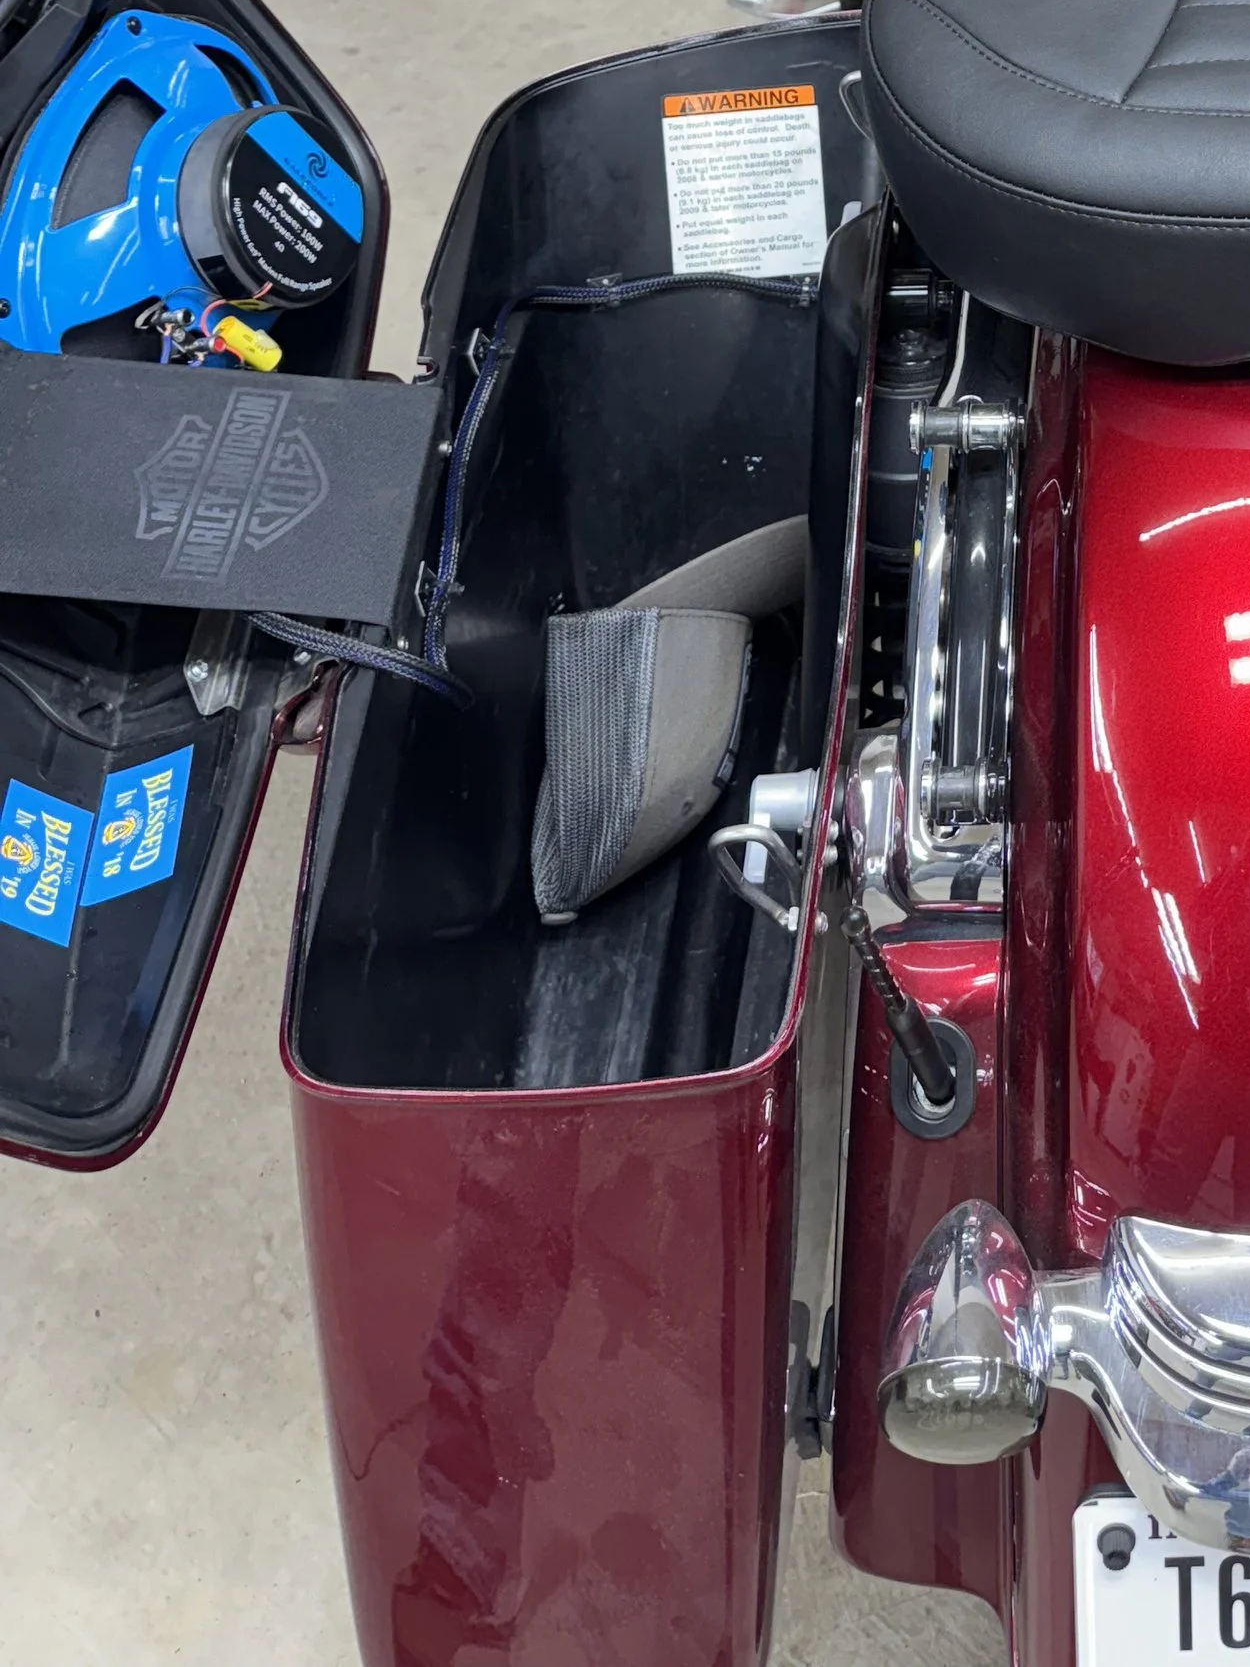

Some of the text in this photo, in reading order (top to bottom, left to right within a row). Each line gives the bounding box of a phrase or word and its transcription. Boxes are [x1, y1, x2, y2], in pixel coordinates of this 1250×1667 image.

[698, 89, 799, 111] WARNING
[233, 197, 242, 219] High
[236, 218, 251, 243] Power
[252, 200, 271, 222] MAX
[294, 240, 317, 264] 200W
[258, 187, 276, 209] RMS
[301, 228, 323, 252] 100W
[147, 430, 208, 523] MOTOR
[175, 396, 278, 573] HARLEY-DAVIDSON
[248, 440, 319, 534] CYCLES
[130, 768, 173, 871] BLESSED
[25, 810, 72, 917] BLESSED
